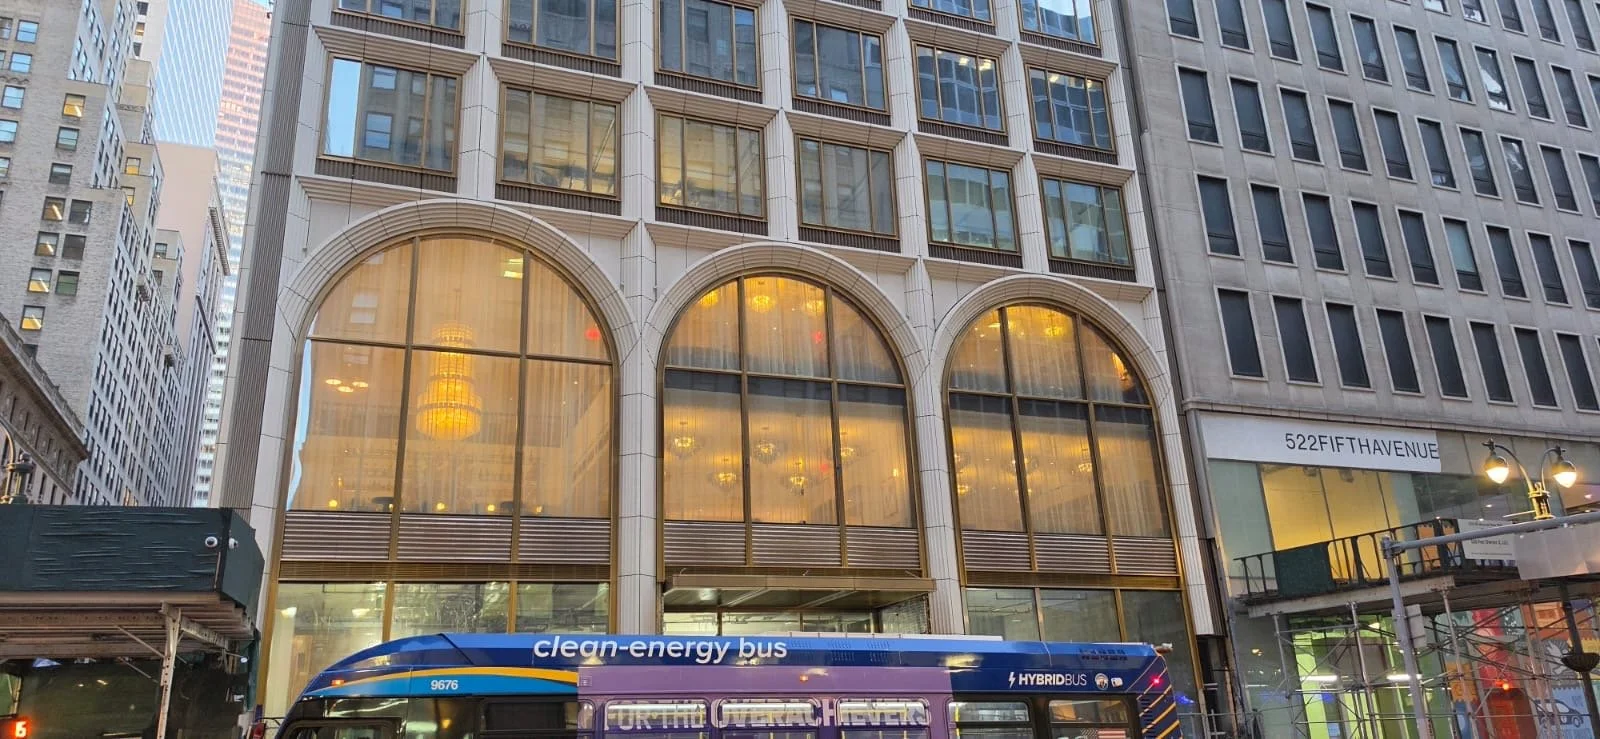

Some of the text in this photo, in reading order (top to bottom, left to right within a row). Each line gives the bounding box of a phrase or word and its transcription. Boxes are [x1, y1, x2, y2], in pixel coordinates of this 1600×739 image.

[1285, 433, 1440, 460] 522FIFTHAVENUE
[533, 635, 788, 664] clean-energy bus
[430, 679, 459, 690] 9676
[1018, 673, 1087, 686] HYBRIDBUS
